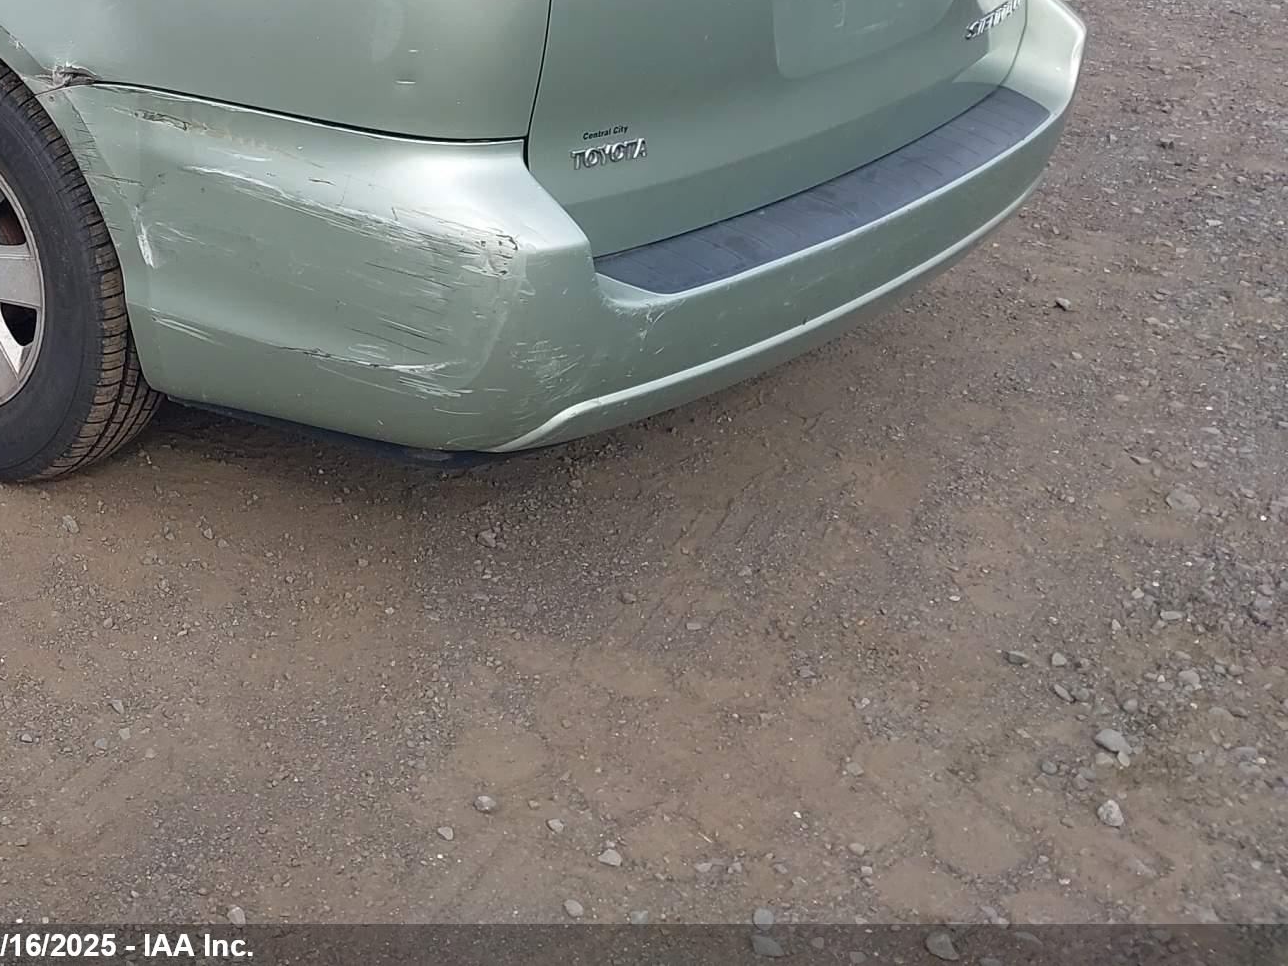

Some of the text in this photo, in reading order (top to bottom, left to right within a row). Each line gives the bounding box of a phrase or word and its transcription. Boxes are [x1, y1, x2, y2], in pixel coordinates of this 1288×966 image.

[582, 125, 629, 141] Central City
[570, 137, 648, 171] TOYOTA
